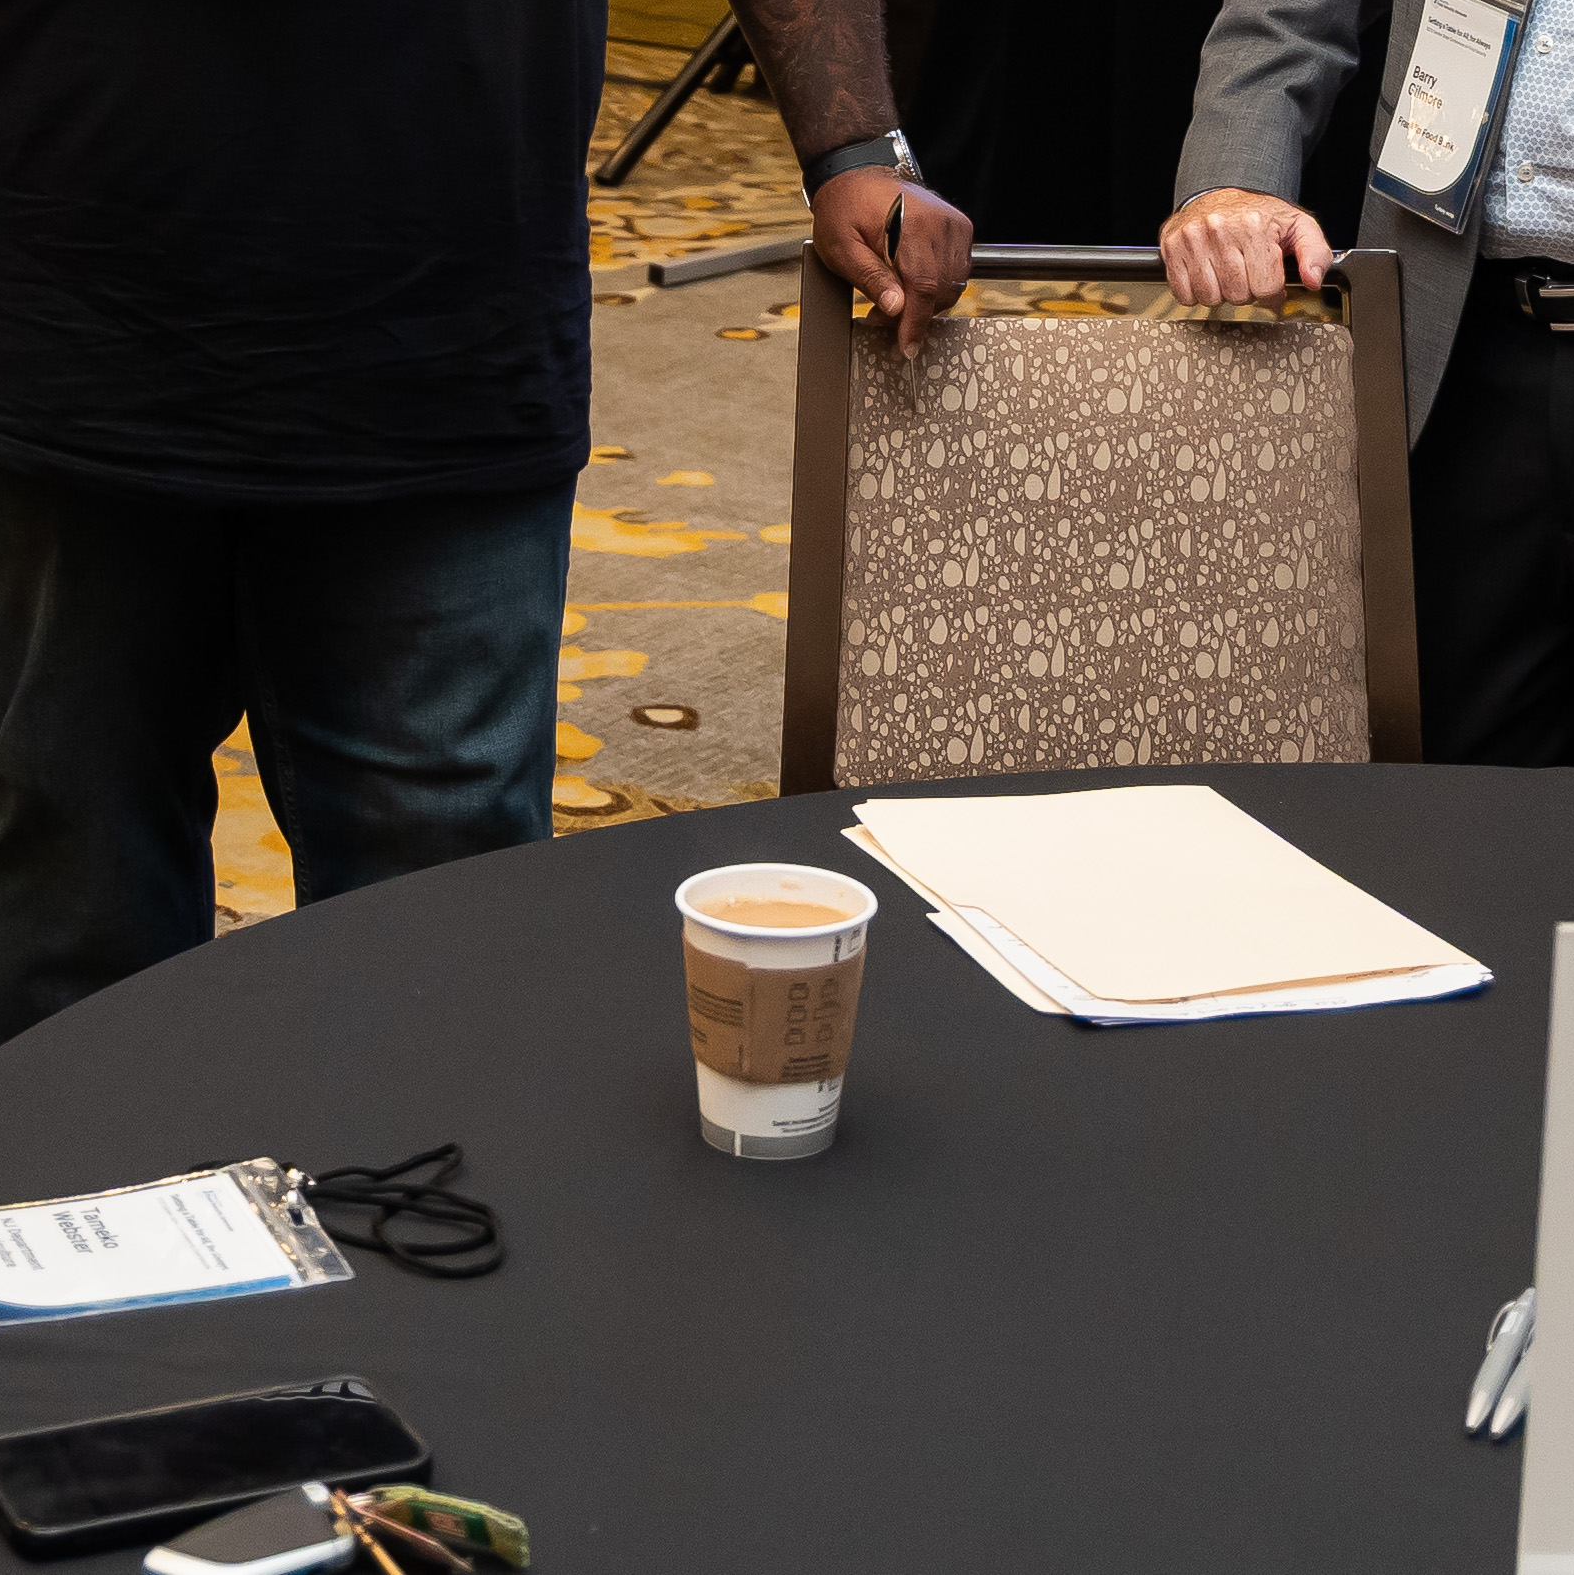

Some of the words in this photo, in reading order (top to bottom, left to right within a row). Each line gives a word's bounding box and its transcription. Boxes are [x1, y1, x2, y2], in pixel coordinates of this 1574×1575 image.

[1412, 65, 1438, 89] Barry
[1408, 83, 1443, 109] Gilmore
[1422, 129, 1438, 143] Food
[1437, 135, 1455, 153] Bnk
[52, 1210, 94, 1253] Webster
[80, 1206, 119, 1249] Tameko
